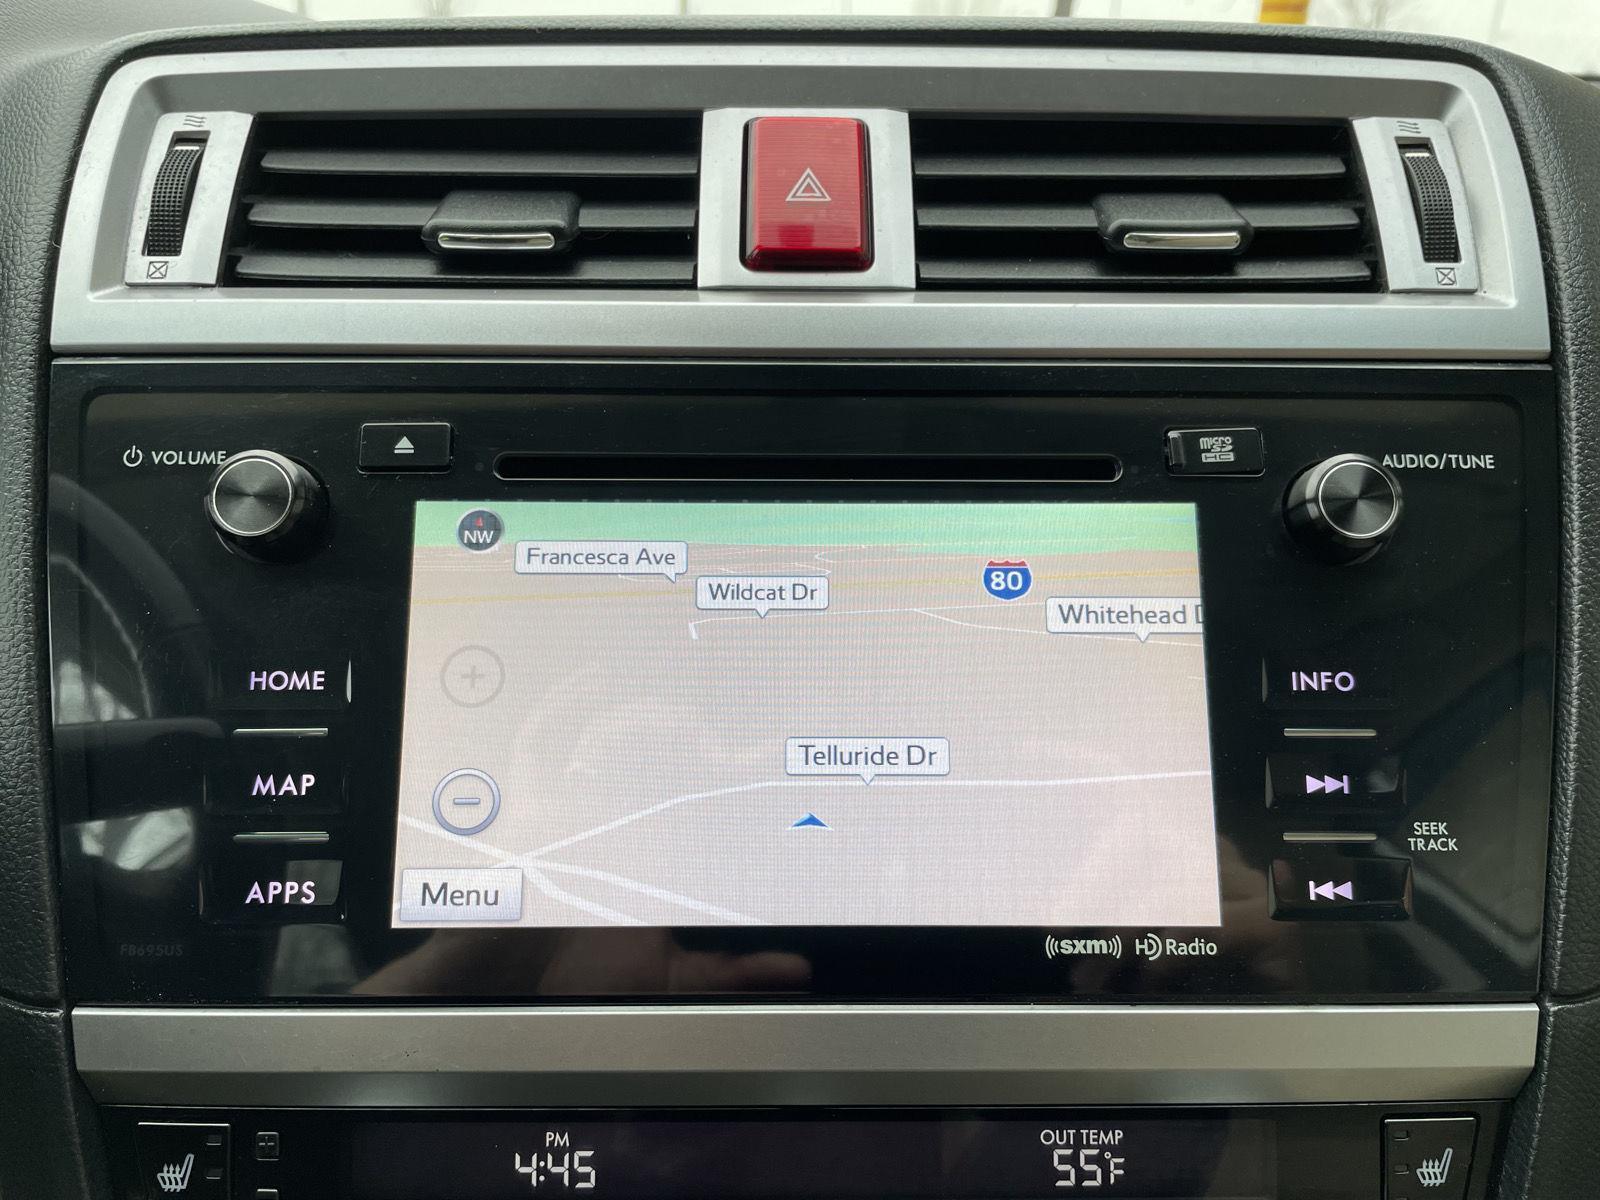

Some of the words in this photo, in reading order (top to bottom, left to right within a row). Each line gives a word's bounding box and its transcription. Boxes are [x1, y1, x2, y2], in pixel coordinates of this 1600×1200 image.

[151, 450, 227, 466] VOLUME
[1382, 453, 1496, 470] AUDIO/TUNE
[462, 530, 494, 545] NW
[526, 547, 630, 566] Francesca
[635, 548, 676, 566] Ave
[990, 571, 1024, 591] 80
[708, 583, 786, 601] Wildcat
[791, 583, 818, 601] Dr
[1058, 603, 1188, 625] Whitehead
[249, 670, 326, 692] HOME
[1291, 671, 1356, 692] INFO
[798, 744, 899, 767] Telluride
[907, 745, 938, 767] Dr
[251, 773, 317, 797] MAP
[1413, 822, 1449, 836] SEEK
[1408, 838, 1459, 852] TRACK
[245, 880, 317, 904] APPS
[420, 881, 500, 907] Menu
[1165, 938, 1218, 956] Radio
[545, 1131, 571, 1148] PM
[1040, 1129, 1079, 1146] OUT
[1080, 1129, 1124, 1146] TEMP
[514, 1150, 597, 1189] 4:45
